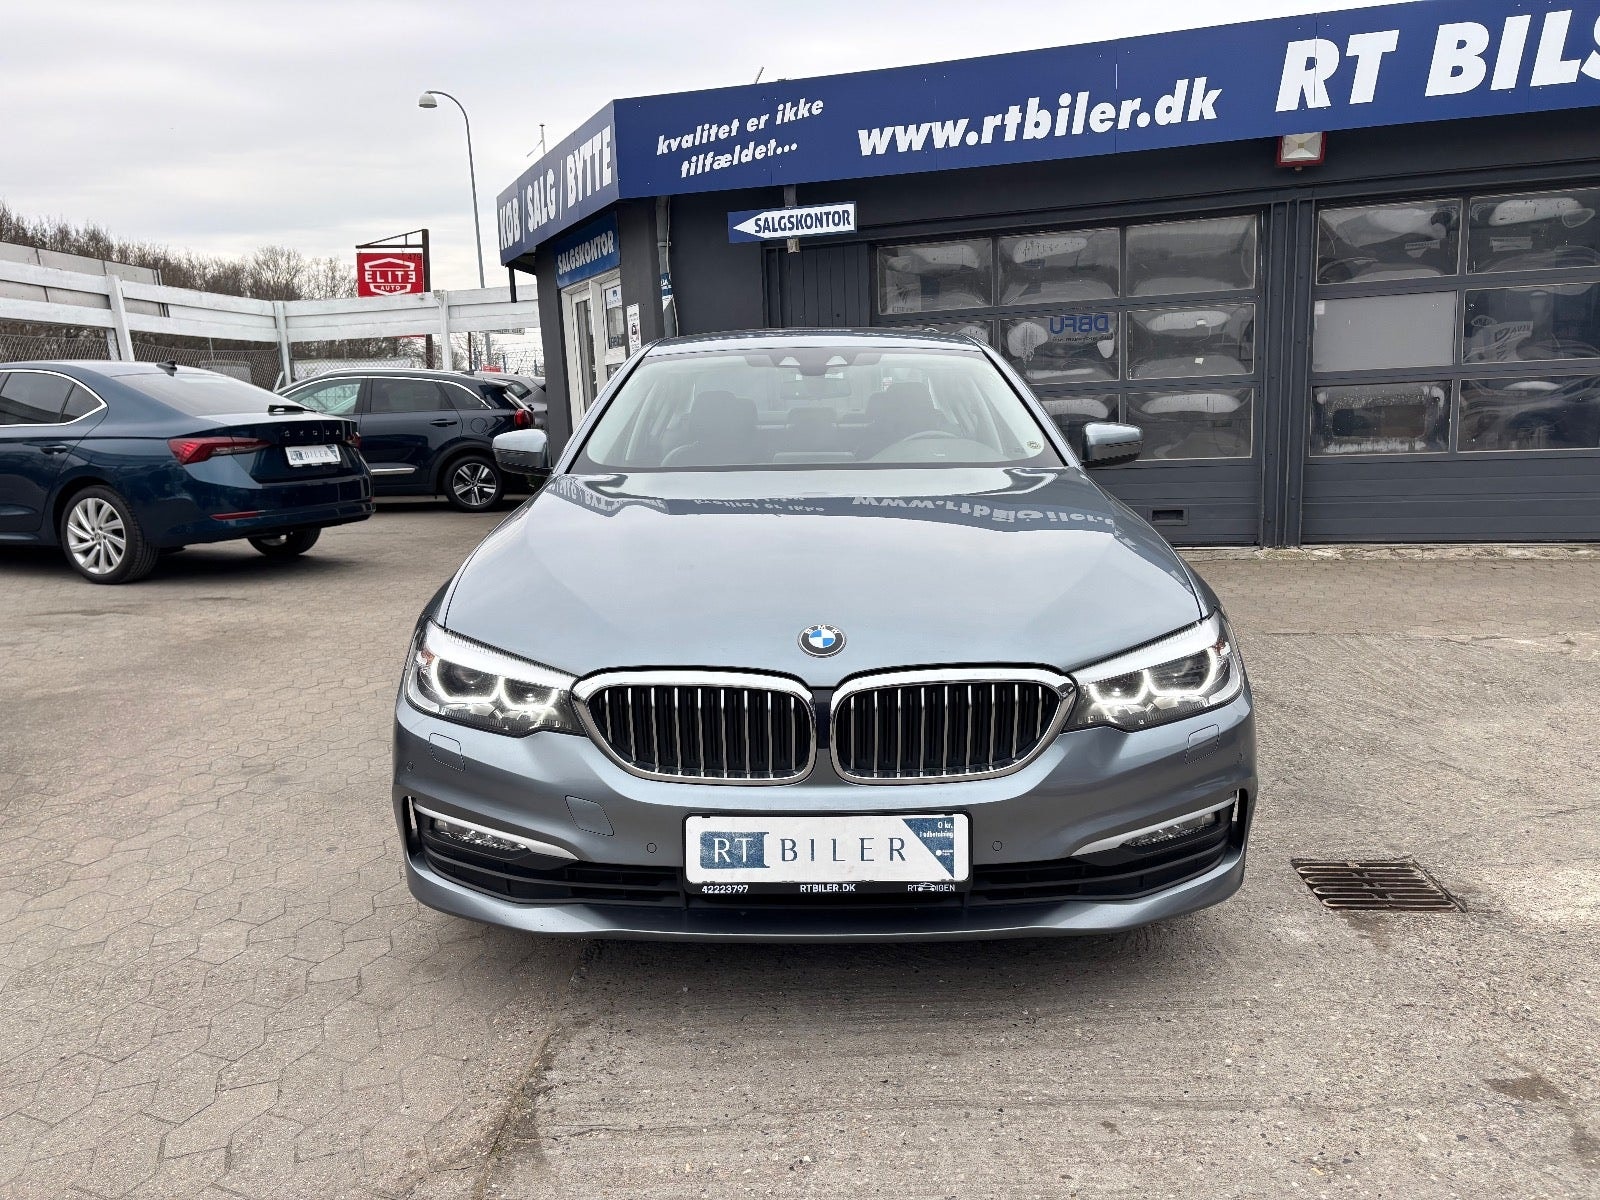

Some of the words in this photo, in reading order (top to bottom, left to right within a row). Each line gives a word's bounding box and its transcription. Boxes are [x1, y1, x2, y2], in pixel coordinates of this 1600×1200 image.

[1275, 29, 1400, 113] RT
[656, 117, 740, 156] kvalitet
[746, 113, 767, 133] er
[775, 98, 825, 126] ikke
[857, 76, 1223, 157] www.rtbiler.dk
[680, 138, 799, 179] tilfældet...
[499, 196, 522, 250] KØB
[527, 168, 557, 232] SALG
[567, 124, 612, 209] BYTTE
[754, 208, 852, 234] SALGSKONTOR
[557, 229, 615, 275] SALGSKONTOR
[364, 270, 417, 283] ELITE
[804, 624, 841, 634] BMW
[944, 820, 953, 829] kr.
[712, 837, 753, 863] RT
[779, 837, 908, 863] BILER
[701, 884, 749, 894] 42223797
[799, 883, 856, 893] RTBILER.DK
